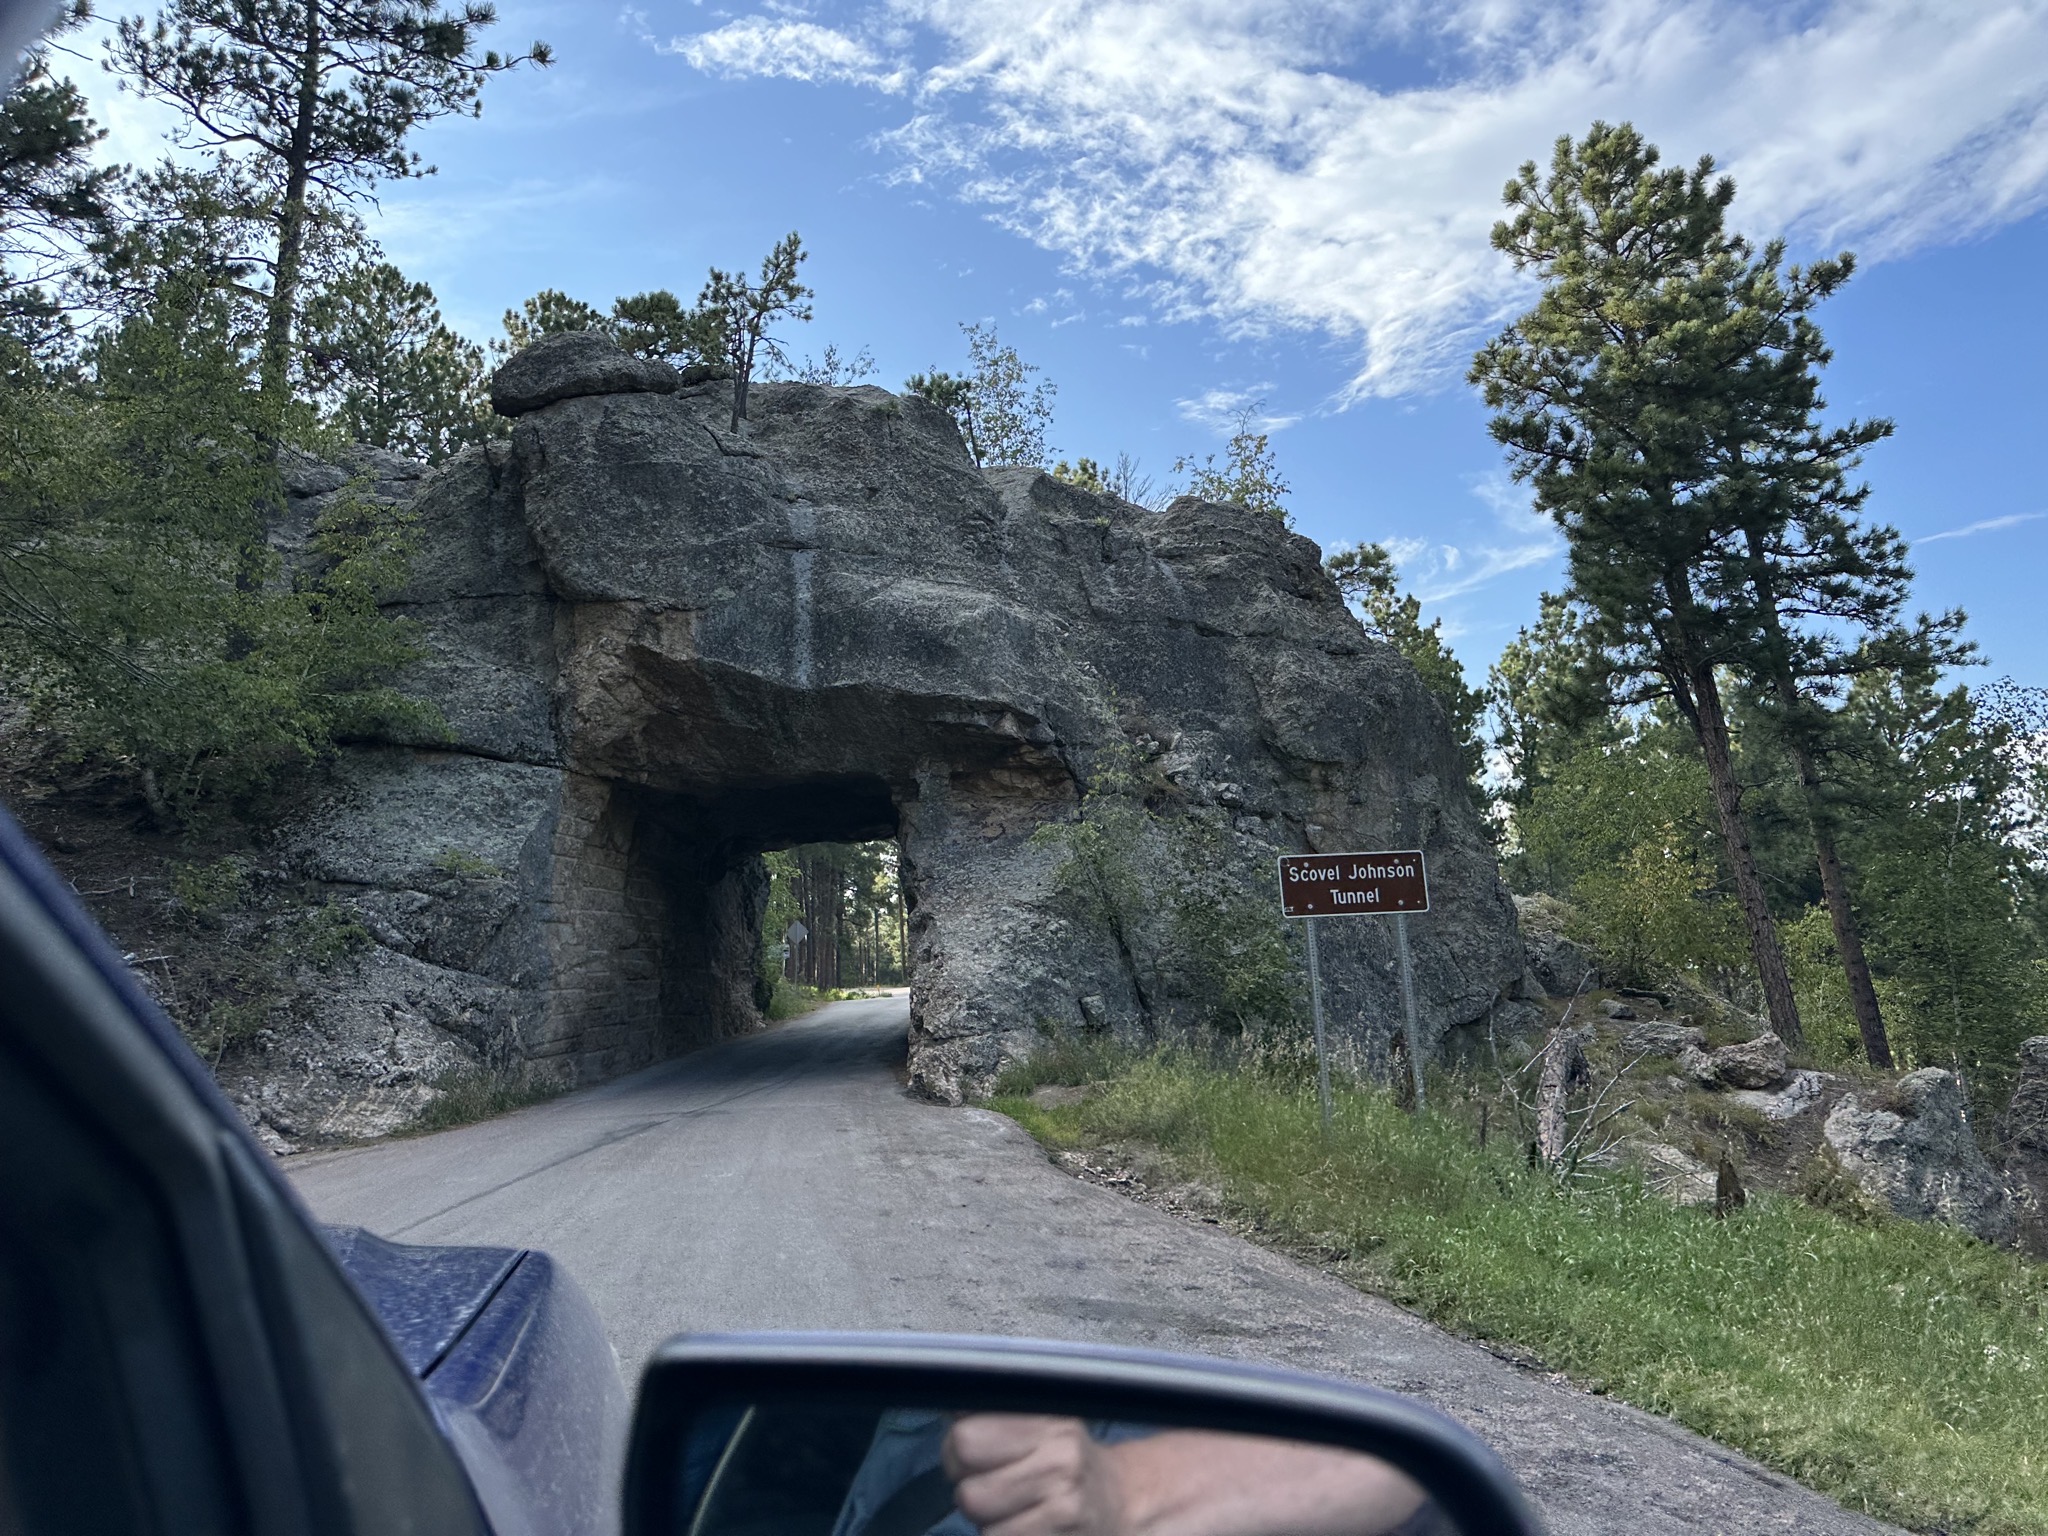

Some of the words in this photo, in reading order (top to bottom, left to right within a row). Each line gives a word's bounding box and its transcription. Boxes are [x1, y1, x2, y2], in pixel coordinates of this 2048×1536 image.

[1289, 865, 1340, 882] Scovel
[1348, 864, 1415, 880] Johnson
[1330, 888, 1380, 905] Tunnel
